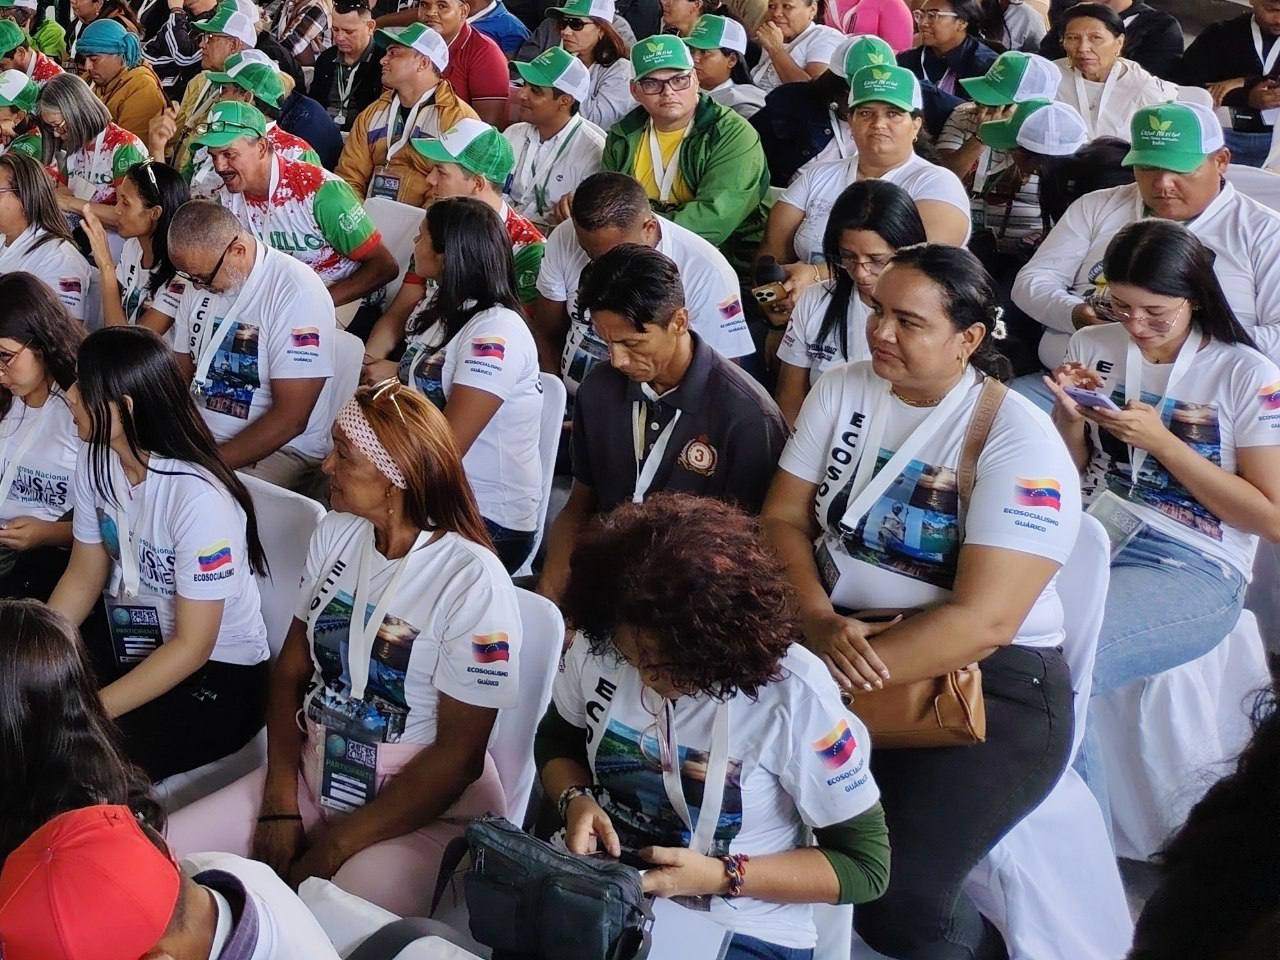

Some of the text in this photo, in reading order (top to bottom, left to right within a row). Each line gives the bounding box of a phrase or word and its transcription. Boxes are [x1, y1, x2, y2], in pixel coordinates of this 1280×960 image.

[694, 448, 705, 463] 3
[35, 469, 69, 481] Nacional
[1003, 507, 1059, 527] ECOSOCIALISMO
[1014, 519, 1047, 533] GUÁRICO
[193, 567, 235, 582] ECOSOCIALISMO
